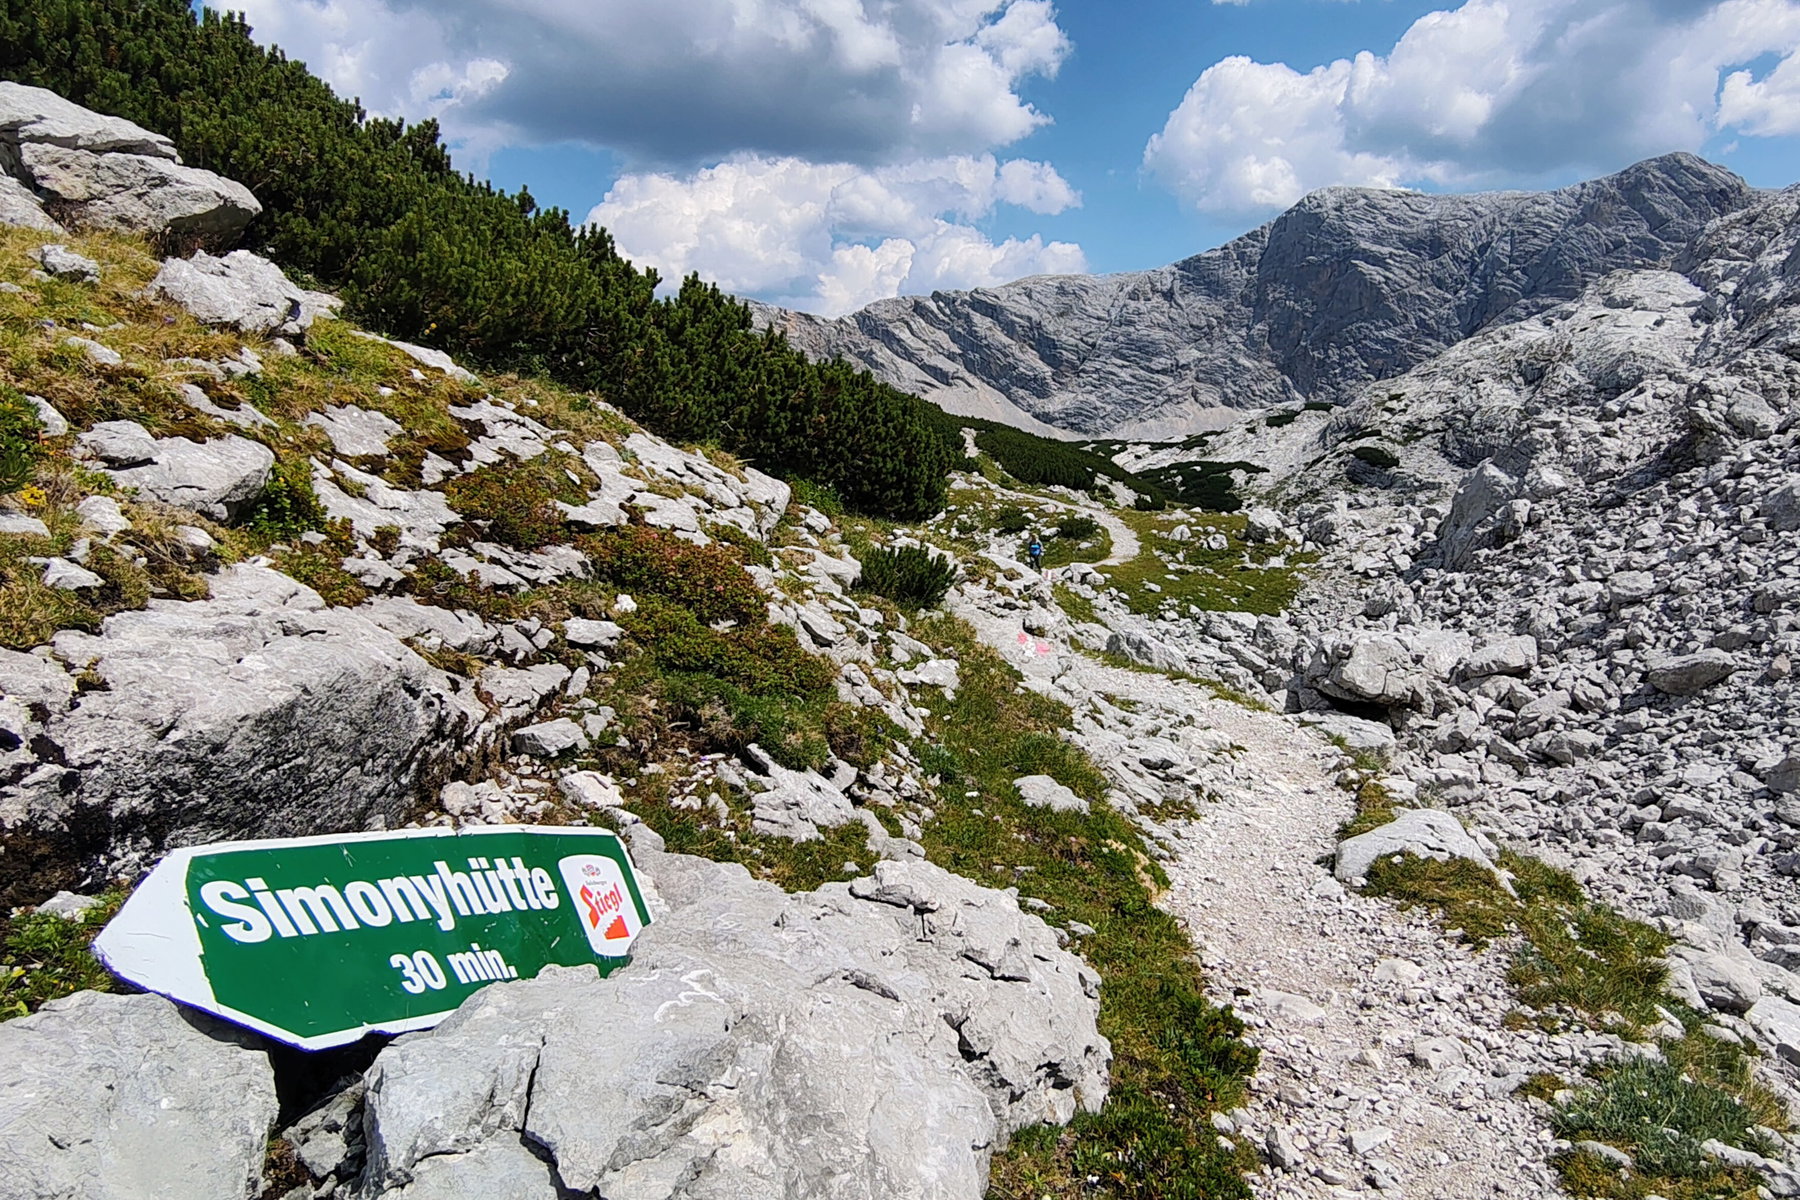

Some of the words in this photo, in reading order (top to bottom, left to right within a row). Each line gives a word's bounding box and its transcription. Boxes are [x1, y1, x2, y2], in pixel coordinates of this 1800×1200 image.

[200, 857, 559, 943] Simonyhütte
[580, 882, 623, 930] Stiegl
[390, 950, 447, 994] 30
[447, 943, 518, 984] min.
